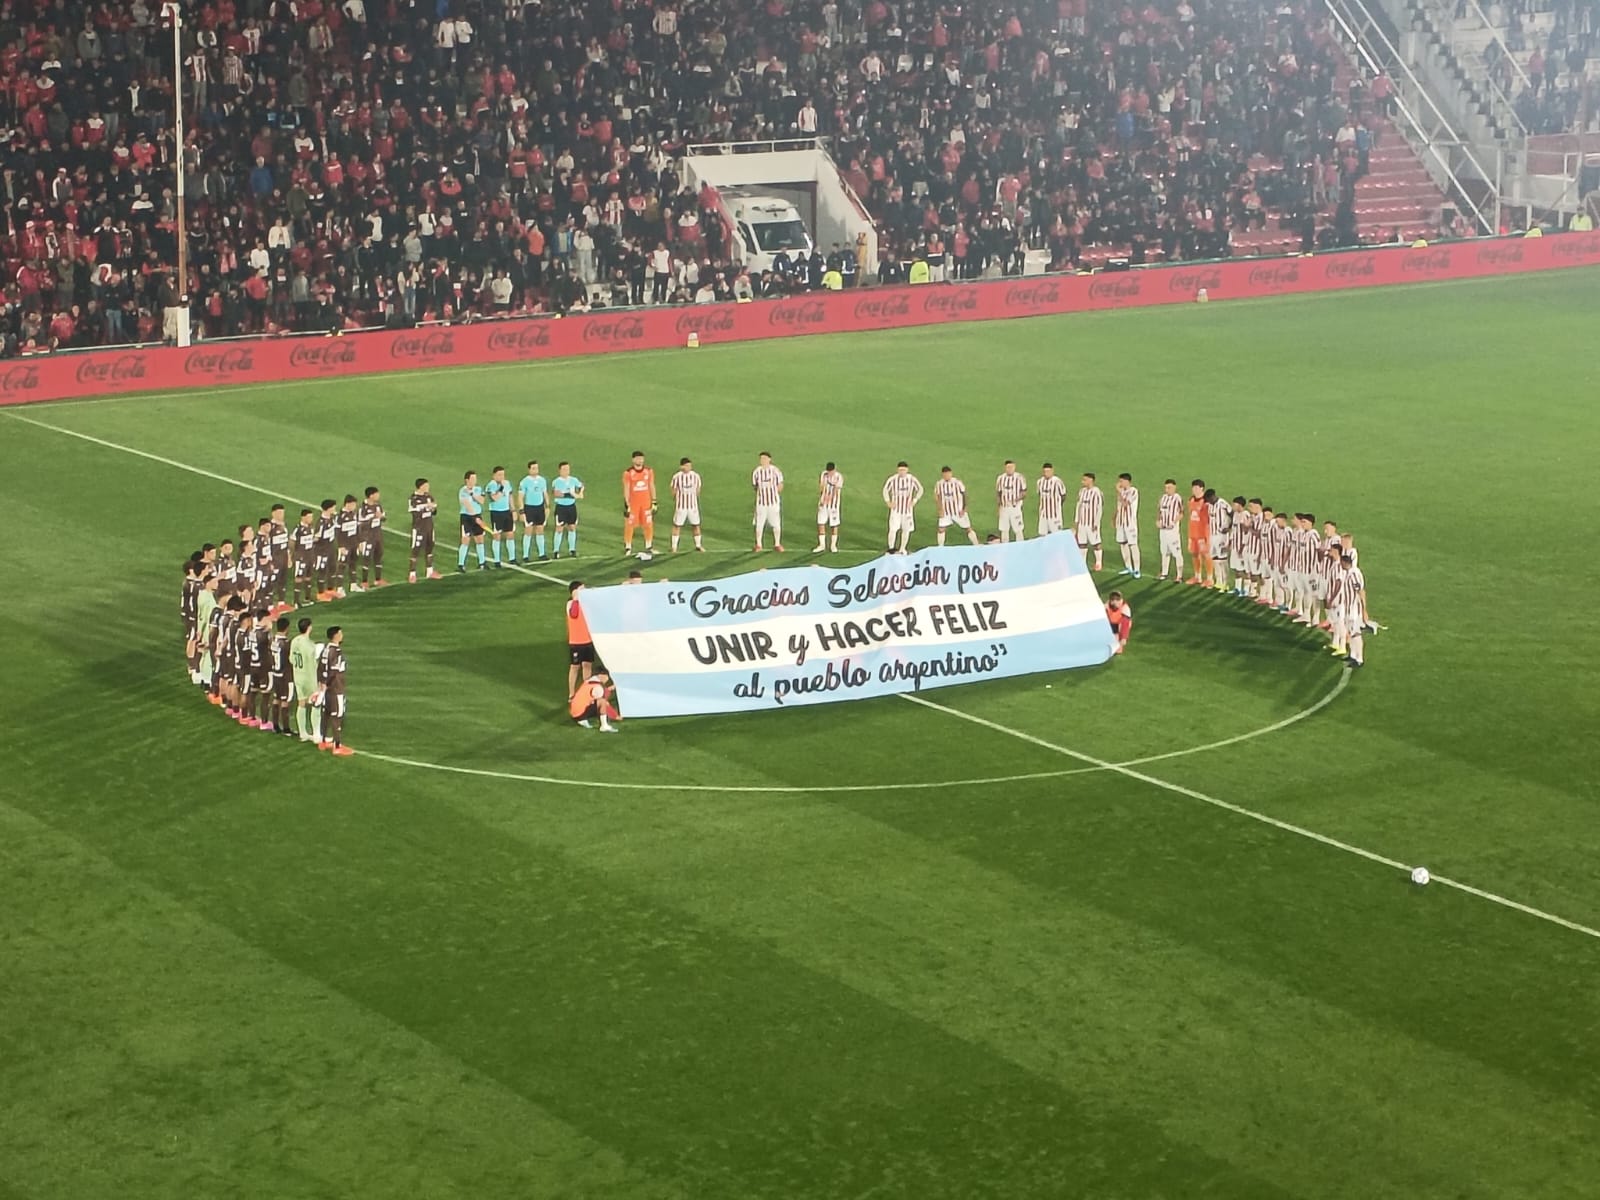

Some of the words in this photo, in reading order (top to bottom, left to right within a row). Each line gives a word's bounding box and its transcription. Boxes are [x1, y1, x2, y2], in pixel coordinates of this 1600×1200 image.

[668, 582, 809, 618] “Gracias
[828, 560, 950, 608] Selección
[958, 562, 998, 594] por
[688, 631, 778, 665] UNIR
[788, 634, 810, 666] y
[815, 607, 922, 651] HACER
[929, 600, 1007, 635] FELIZ
[733, 672, 765, 698] al
[774, 659, 871, 704] pueblo
[878, 643, 1008, 692] argentino”
